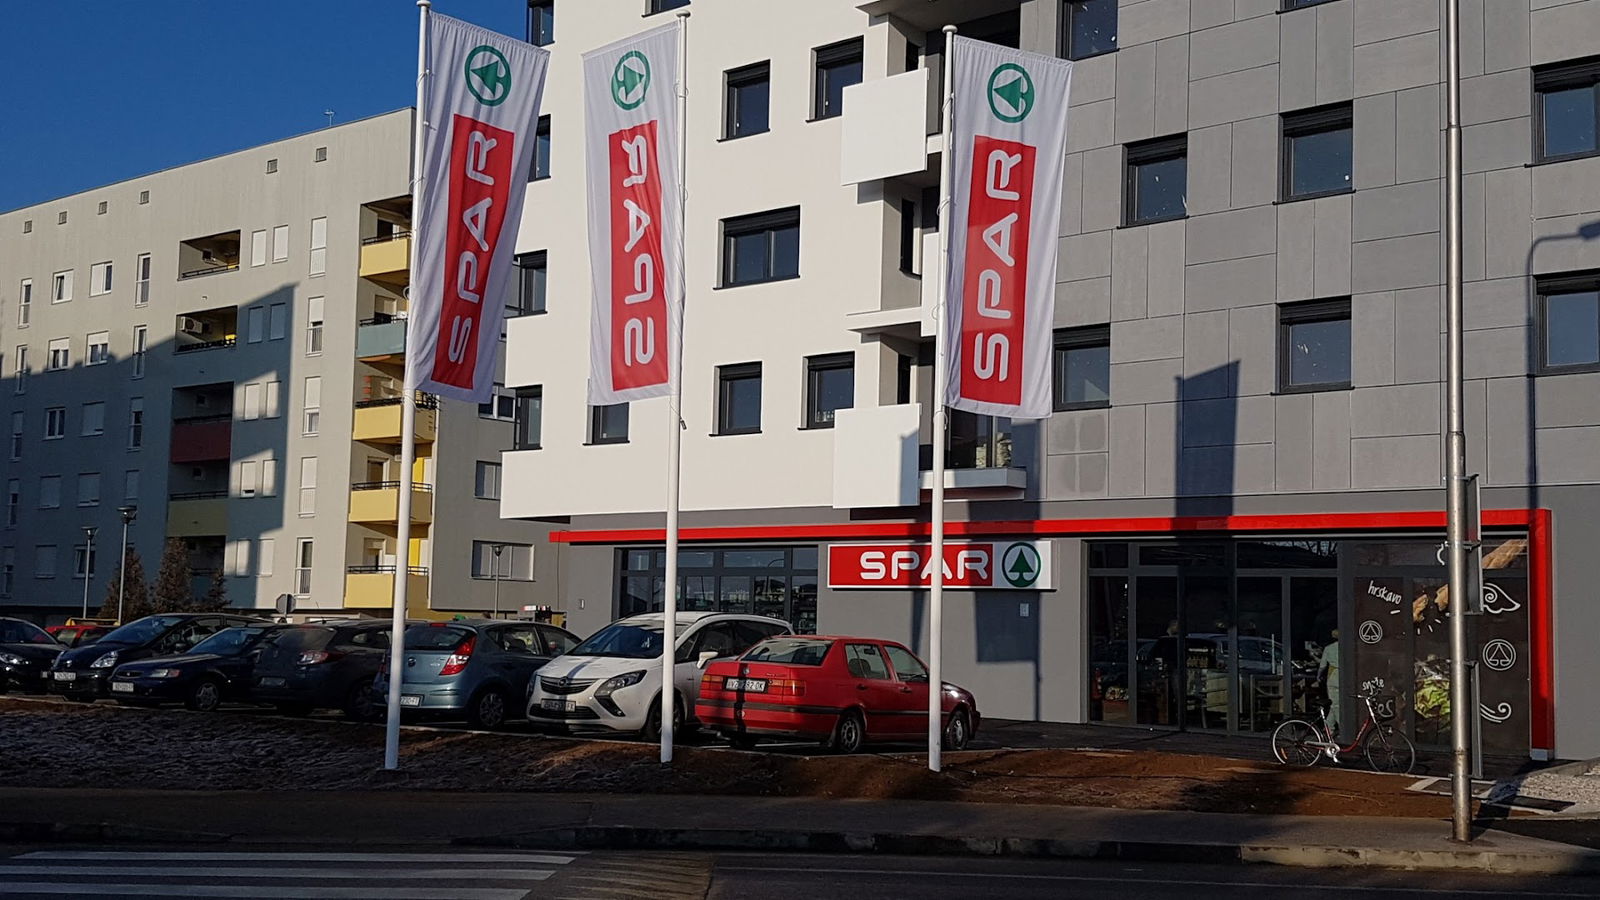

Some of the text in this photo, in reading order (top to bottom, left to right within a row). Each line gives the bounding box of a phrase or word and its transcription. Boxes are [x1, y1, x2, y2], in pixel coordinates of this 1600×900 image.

[448, 130, 497, 364] SPAR
[973, 149, 1022, 382] SPAR
[860, 550, 989, 580] SPAR
[1367, 579, 1402, 605] hrskavo
